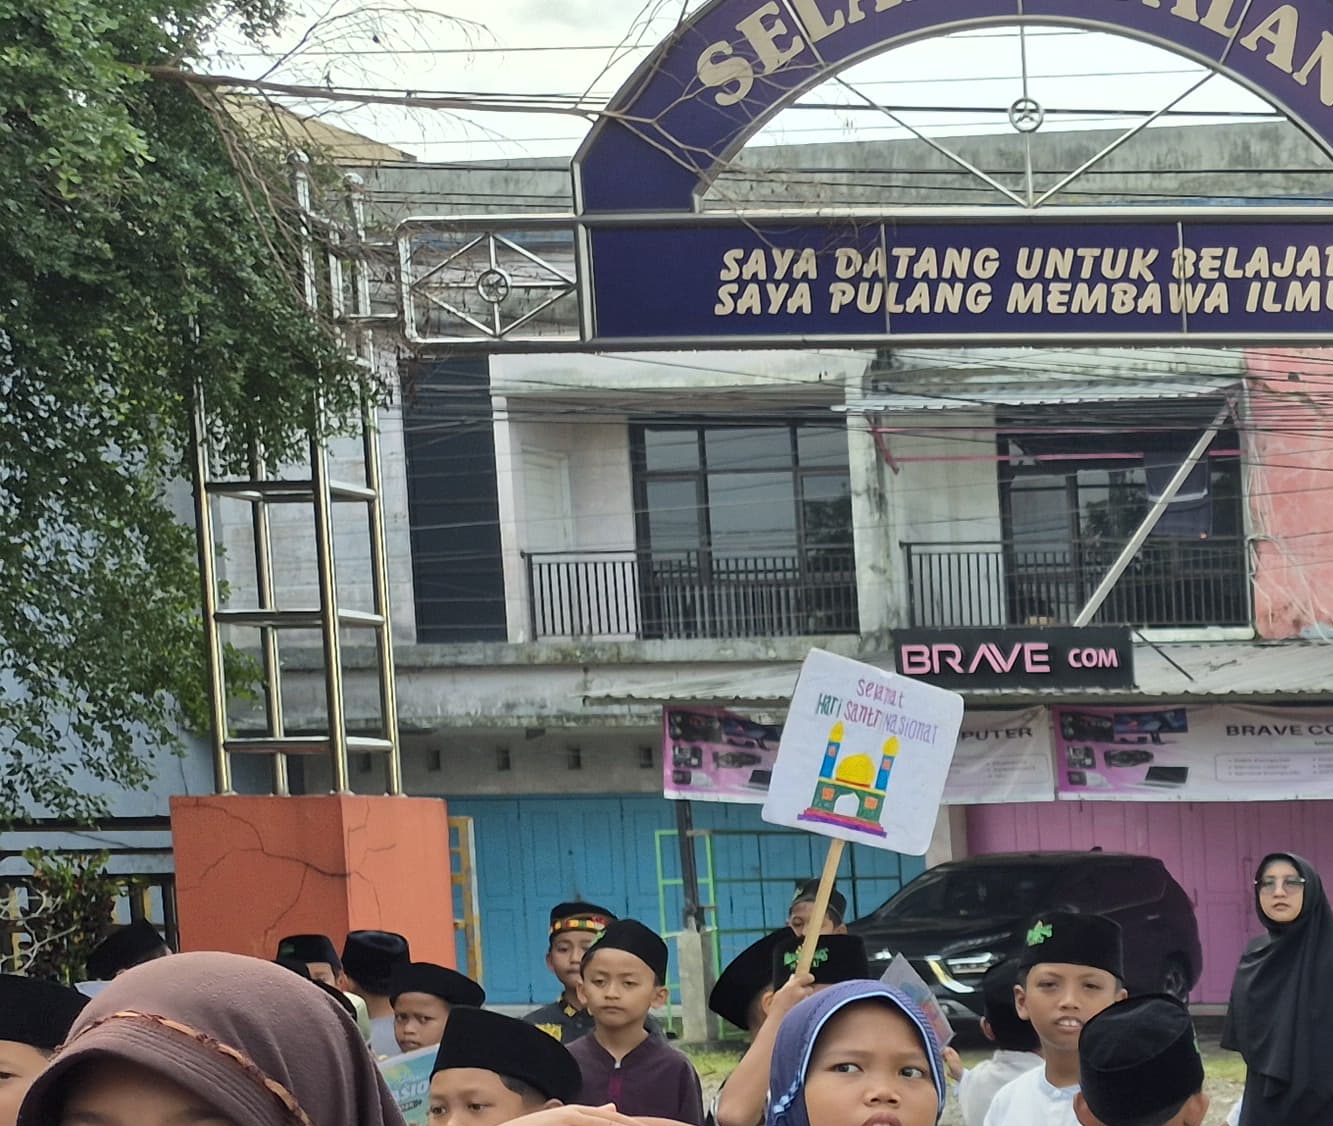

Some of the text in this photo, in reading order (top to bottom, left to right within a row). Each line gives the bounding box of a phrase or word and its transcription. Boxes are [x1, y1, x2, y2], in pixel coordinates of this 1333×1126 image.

[720, 247, 818, 281] SAYA
[834, 246, 1001, 280] DATANG
[1015, 246, 1160, 282] UNTUK
[713, 281, 812, 316] SAYA
[828, 281, 993, 315] PULANG
[1005, 281, 1230, 315] MEMBAWA
[900, 642, 1119, 675] BRAVE COM
[960, 727, 1033, 741] PUTER
[1225, 724, 1302, 737] BRAVE
